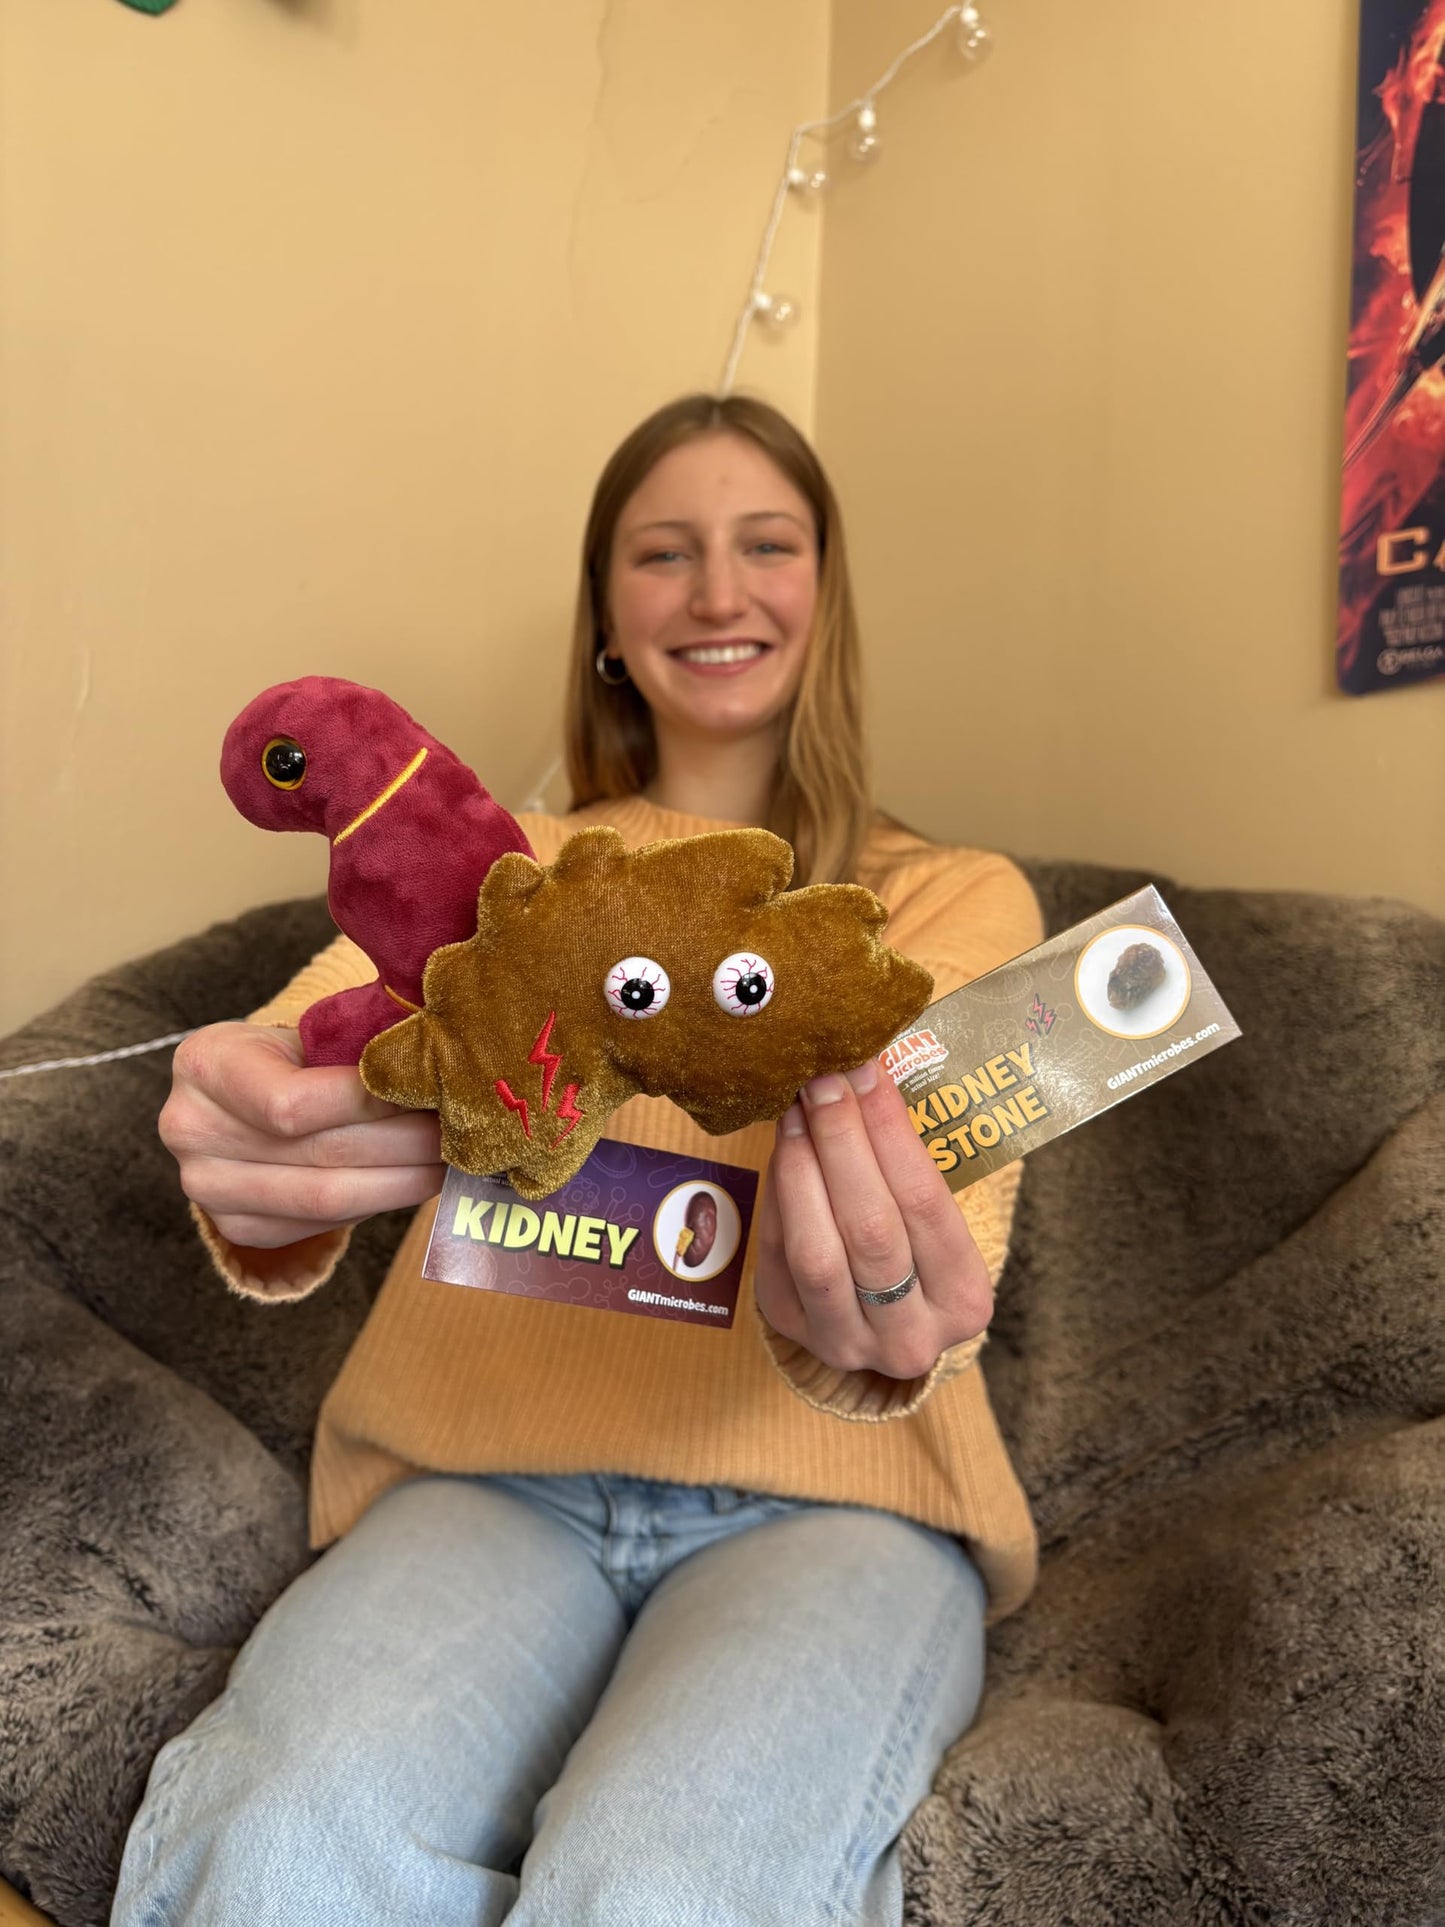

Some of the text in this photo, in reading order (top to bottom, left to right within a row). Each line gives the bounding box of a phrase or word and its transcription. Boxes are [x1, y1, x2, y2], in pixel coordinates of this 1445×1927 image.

[880, 1030, 938, 1070] GIANT
[1106, 1022, 1221, 1090] GIANTmicrobes.com
[906, 1041, 1038, 1135] KIDNEY
[926, 1085, 1048, 1173] STONE
[451, 1195, 640, 1268] KIDNEY
[627, 1288, 729, 1316] GIANTmicrobes.com
